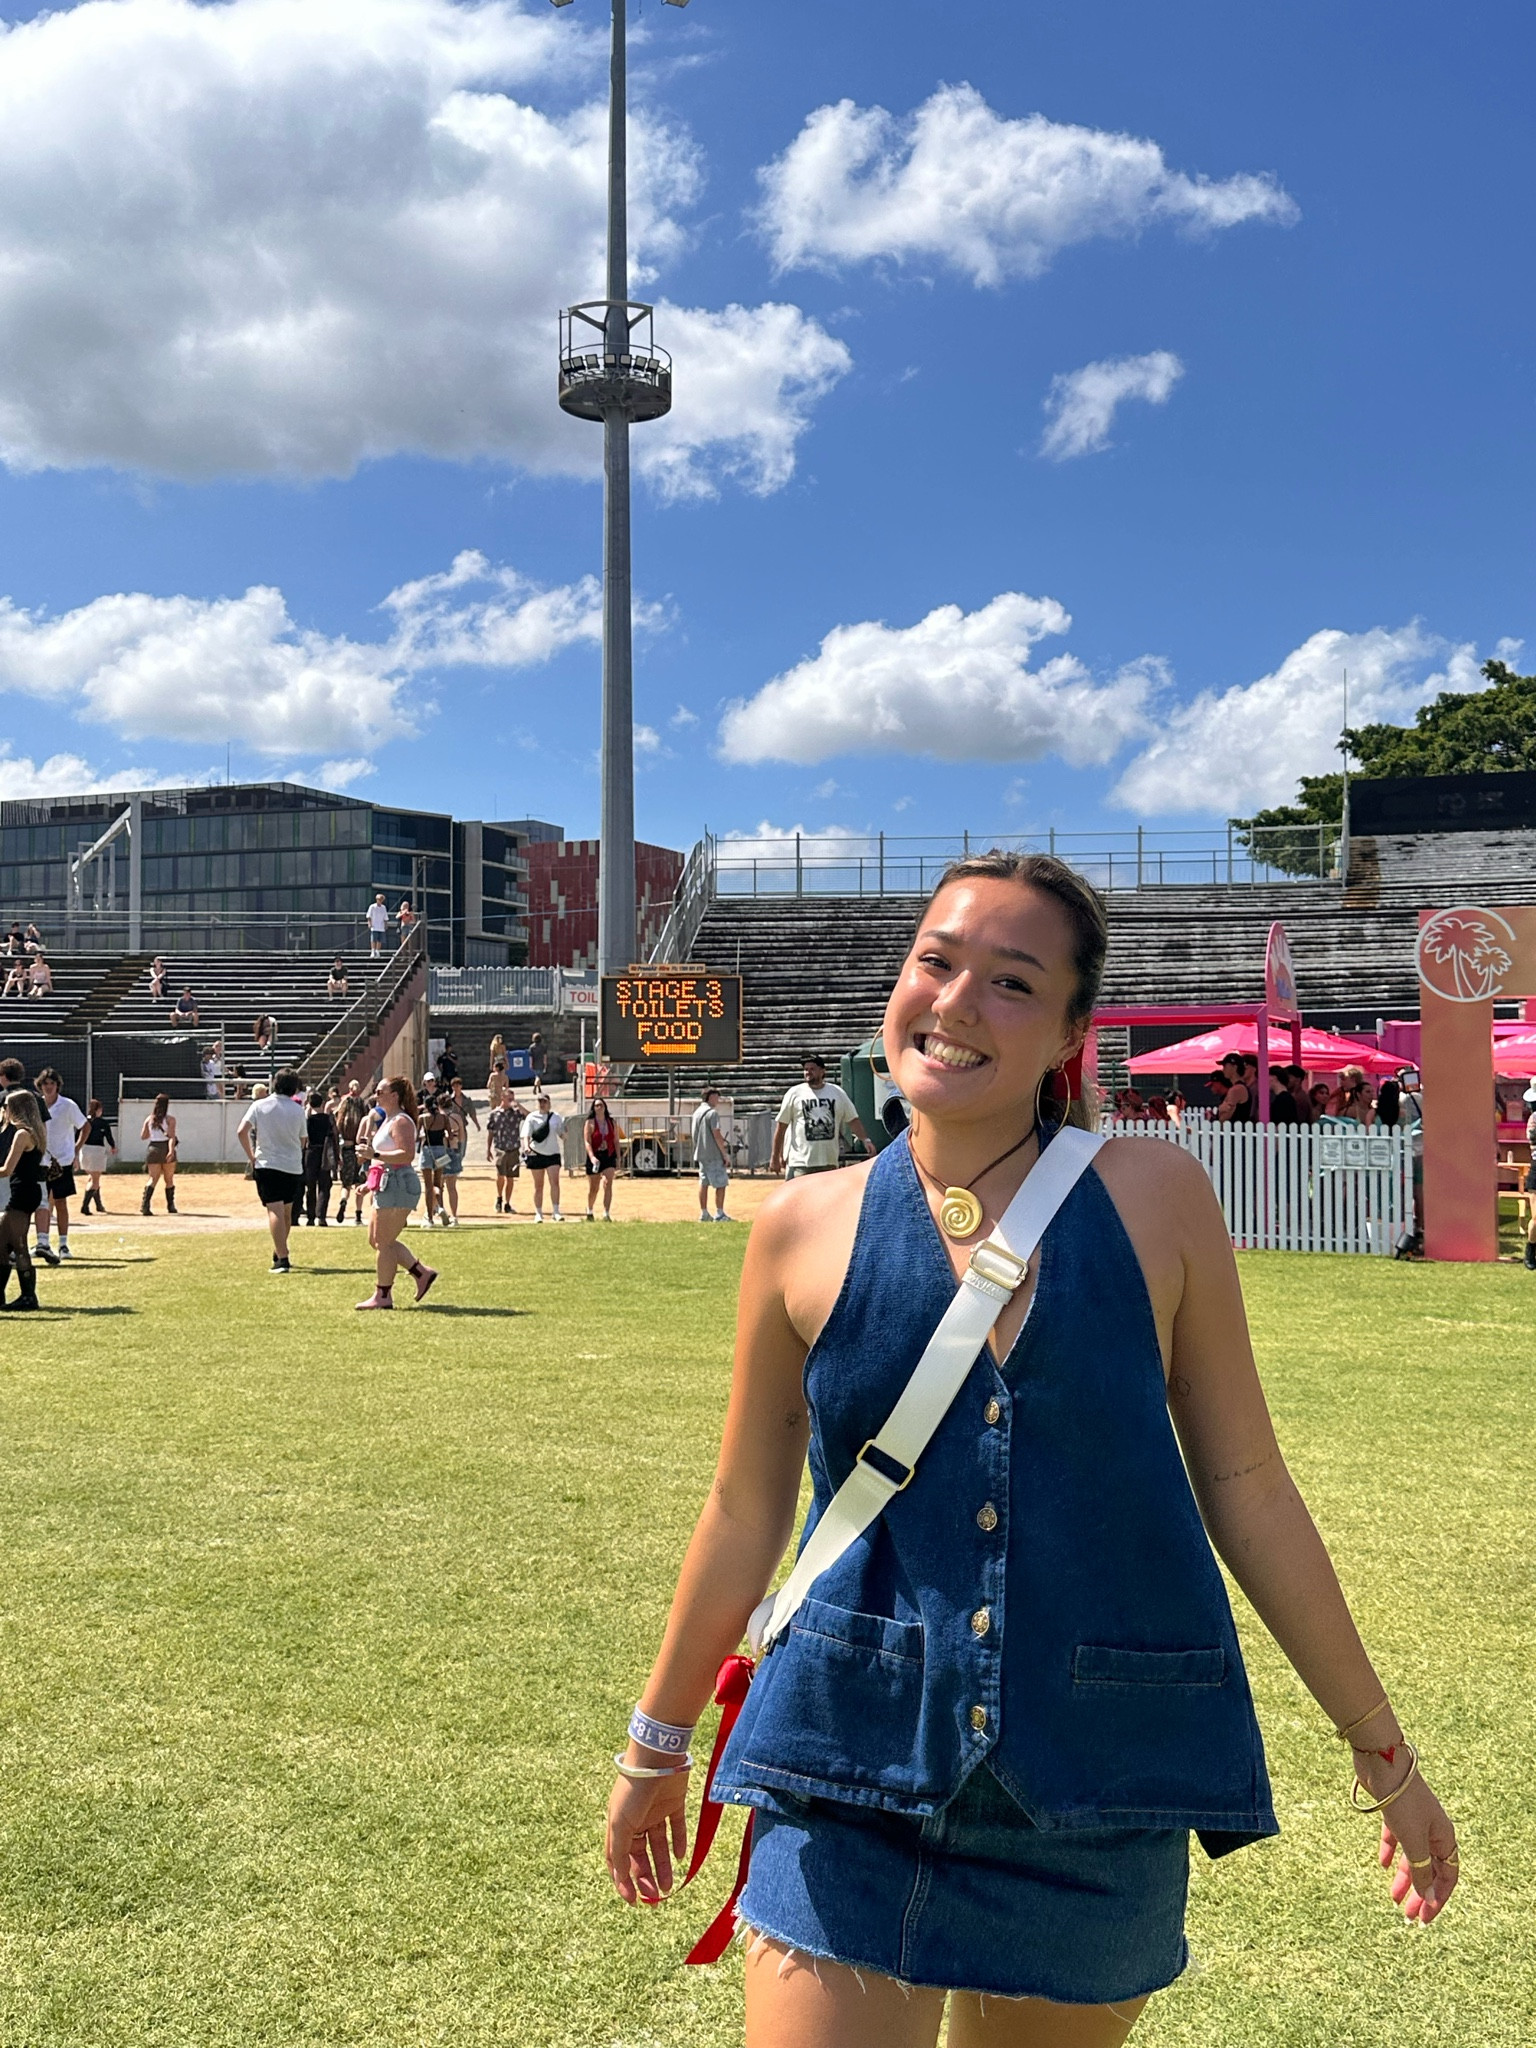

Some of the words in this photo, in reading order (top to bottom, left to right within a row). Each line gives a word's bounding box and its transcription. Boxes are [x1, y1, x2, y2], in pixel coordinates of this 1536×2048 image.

[569, 991, 598, 1003] TOIL
[616, 980, 697, 999] STAGE
[706, 980, 722, 999] 3
[616, 1000, 724, 1018] TOILETS
[637, 1021, 702, 1040] FOOD
[658, 1731, 681, 1749] GA
